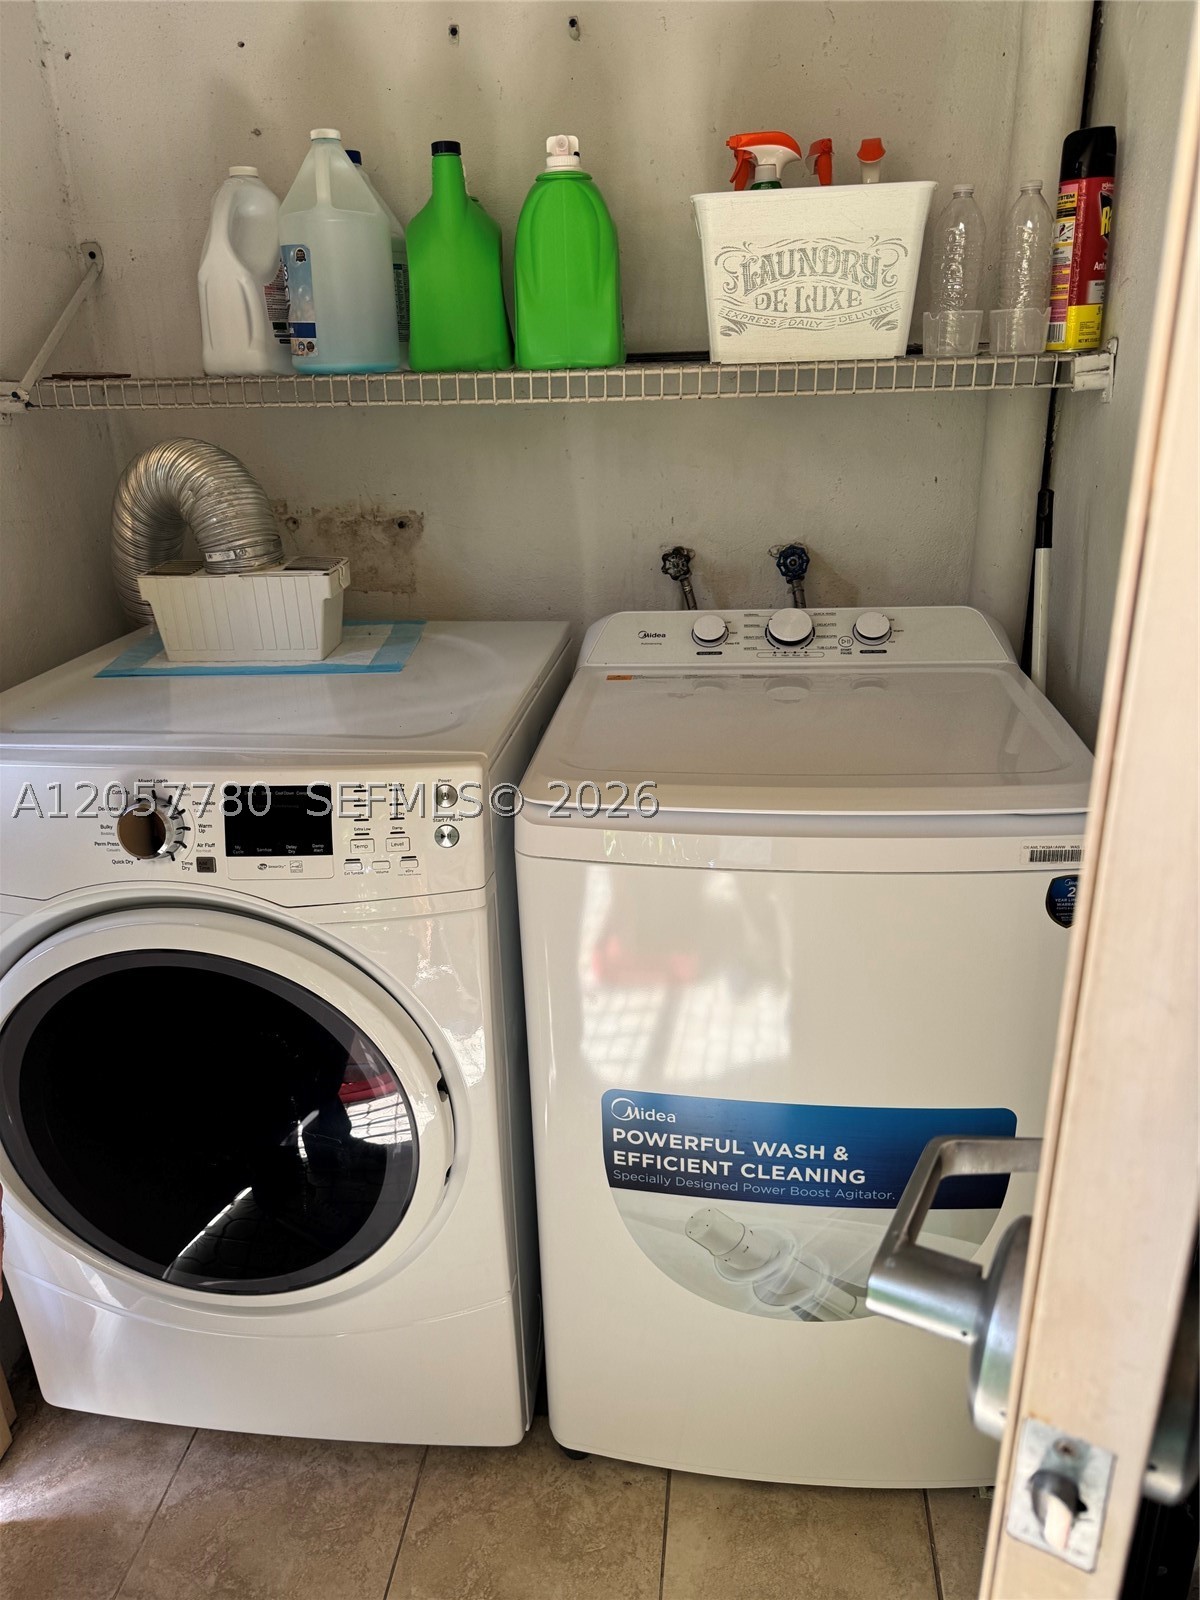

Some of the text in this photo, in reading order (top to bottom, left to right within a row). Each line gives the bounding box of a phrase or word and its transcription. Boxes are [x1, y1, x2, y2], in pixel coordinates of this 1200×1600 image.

[739, 245, 882, 297] LAUNDRY
[754, 285, 862, 314] DE LUXE
[725, 303, 895, 329] EXPRESS DAILY DELIVERY
[639, 631, 666, 639] Midea
[1067, 886, 1077, 897] 2
[611, 1097, 677, 1123] Midea
[612, 1127, 849, 1161] POWERFUL WASH &
[613, 1150, 866, 1185] EFFICIENT CLEANING
[612, 1169, 896, 1201] Specially Designed Power Boost Agitator.
